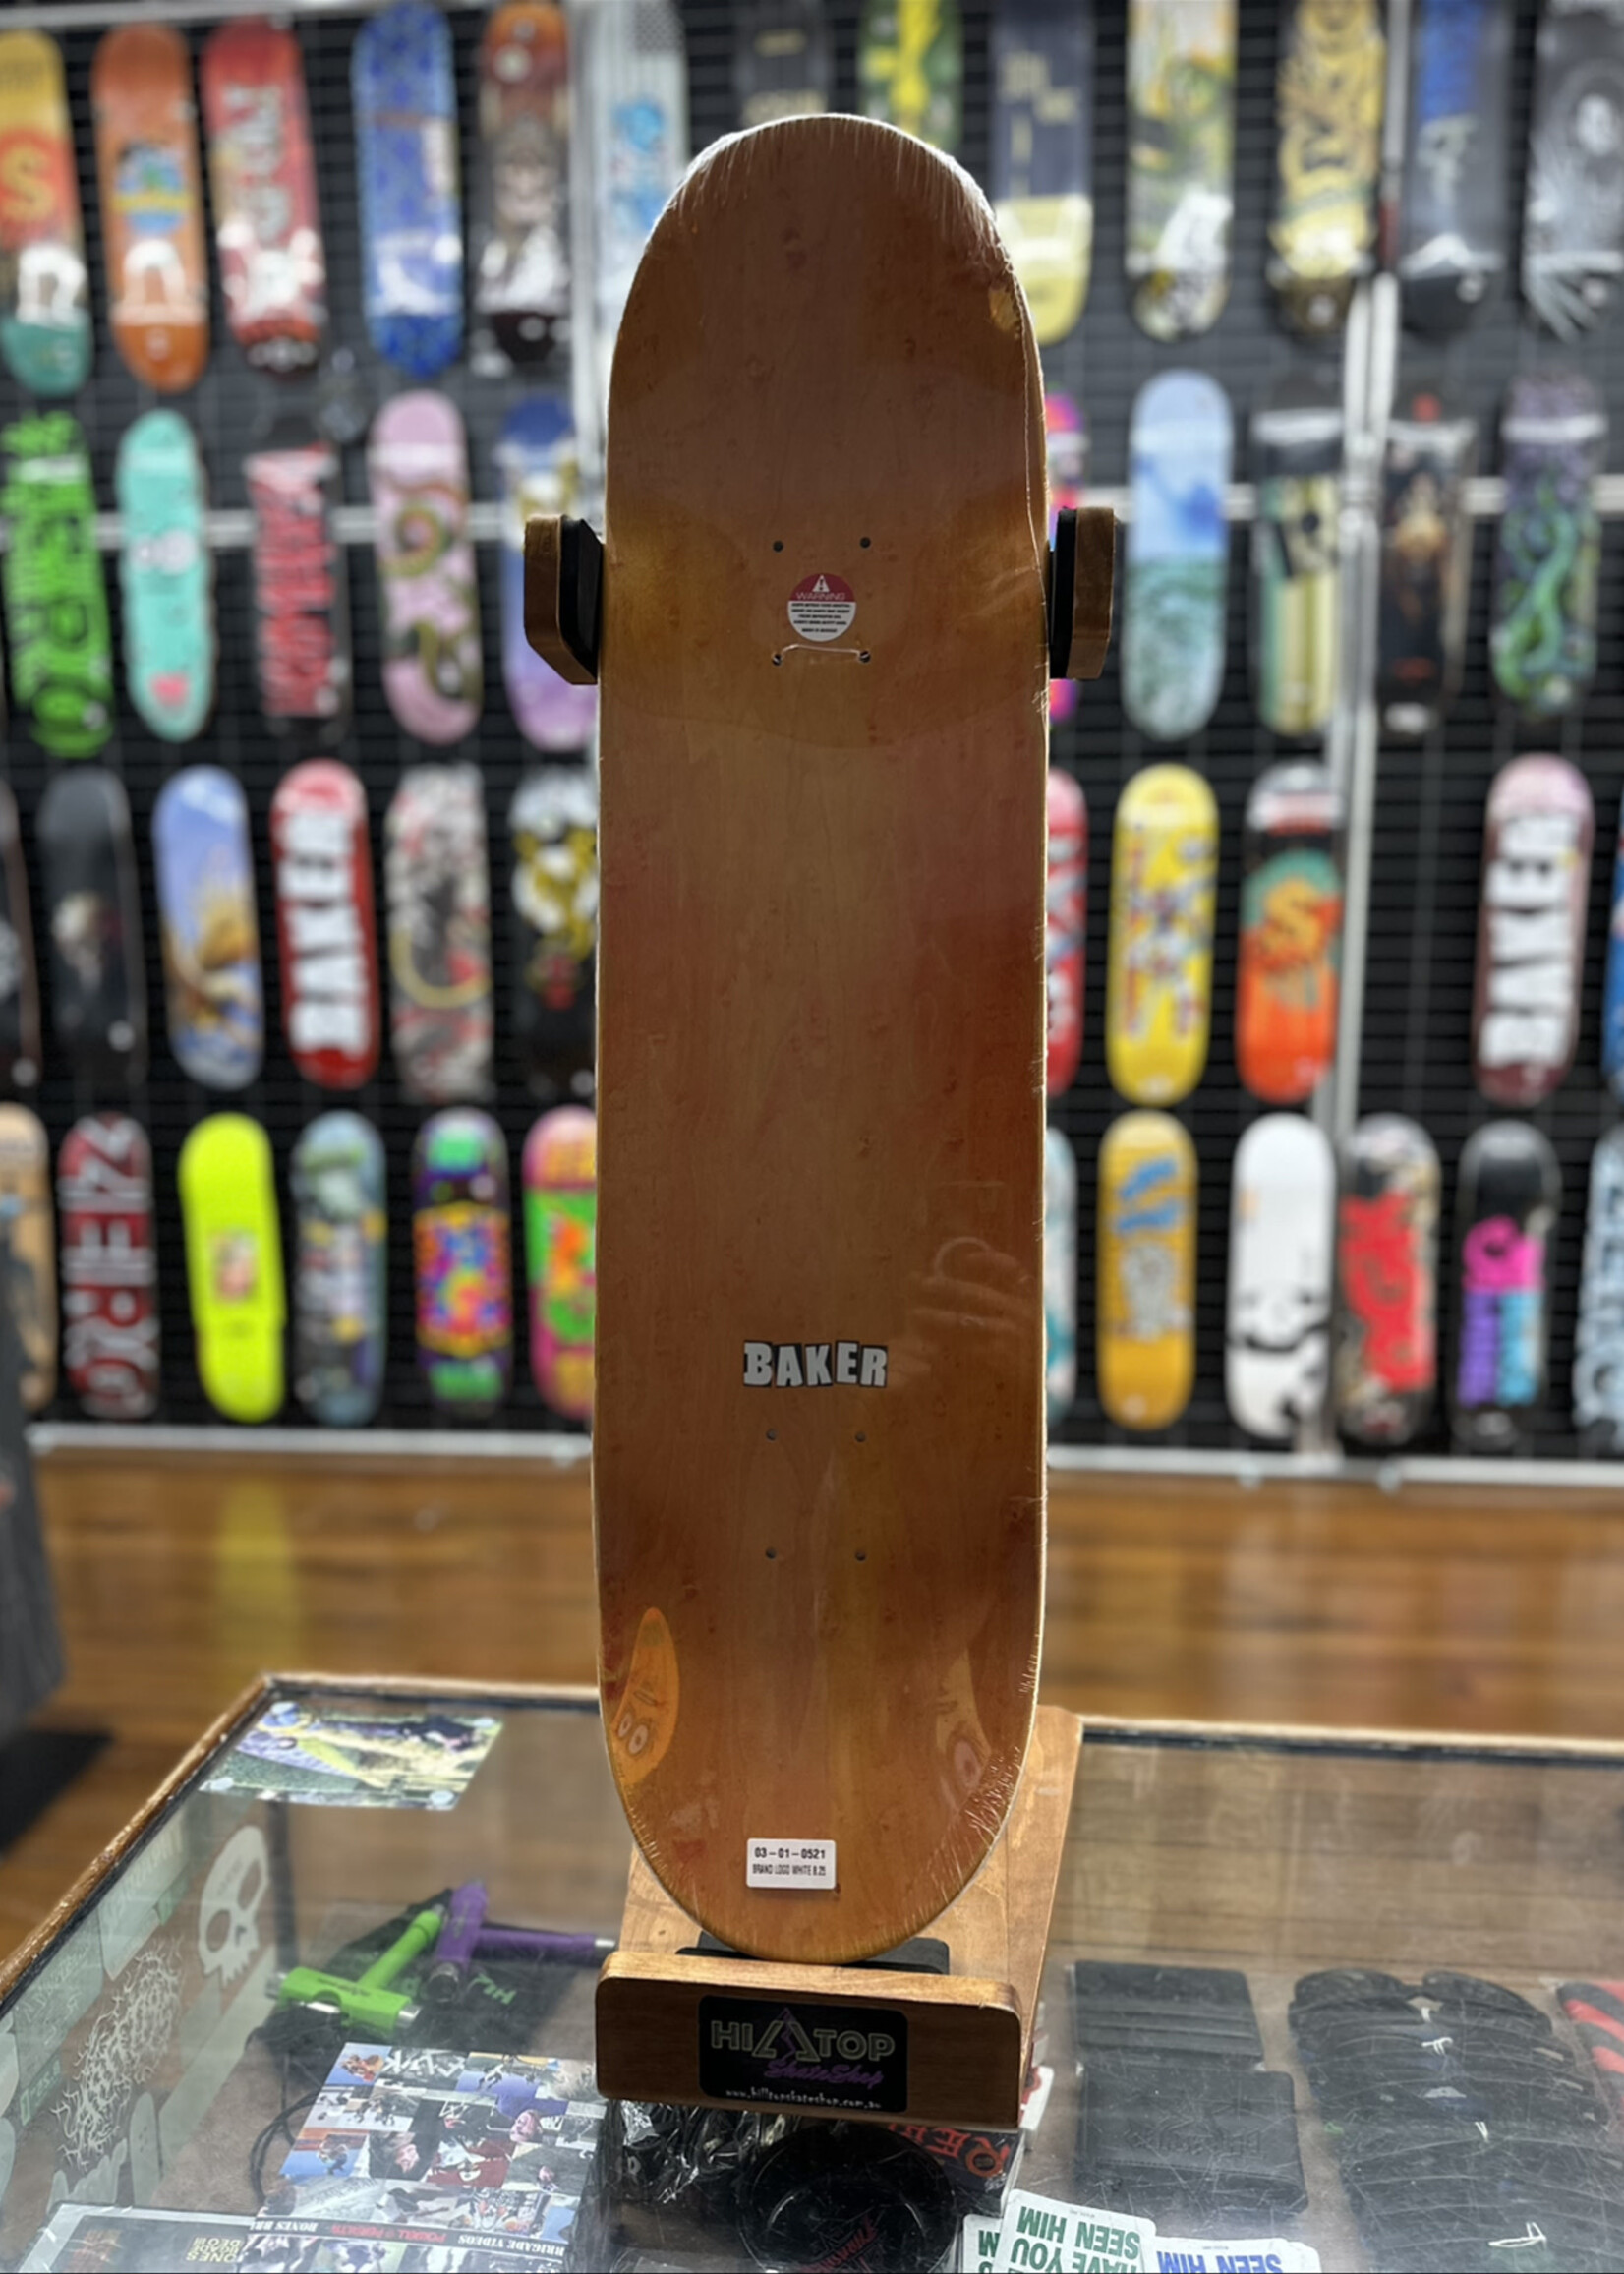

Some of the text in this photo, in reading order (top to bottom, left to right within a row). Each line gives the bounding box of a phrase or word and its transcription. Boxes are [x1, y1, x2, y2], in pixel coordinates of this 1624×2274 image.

[796, 591, 845, 601] WARNING
[743, 1340, 888, 1387] BAKER
[275, 2221, 319, 2233] BONES
[1016, 2206, 1140, 2260] SEEN HIM
[458, 2234, 504, 2248] VIDEOS
[186, 2250, 238, 2262] ONES
[1010, 2238, 1062, 2273] YOU
[1157, 2251, 1283, 2273] SEEN HIM
